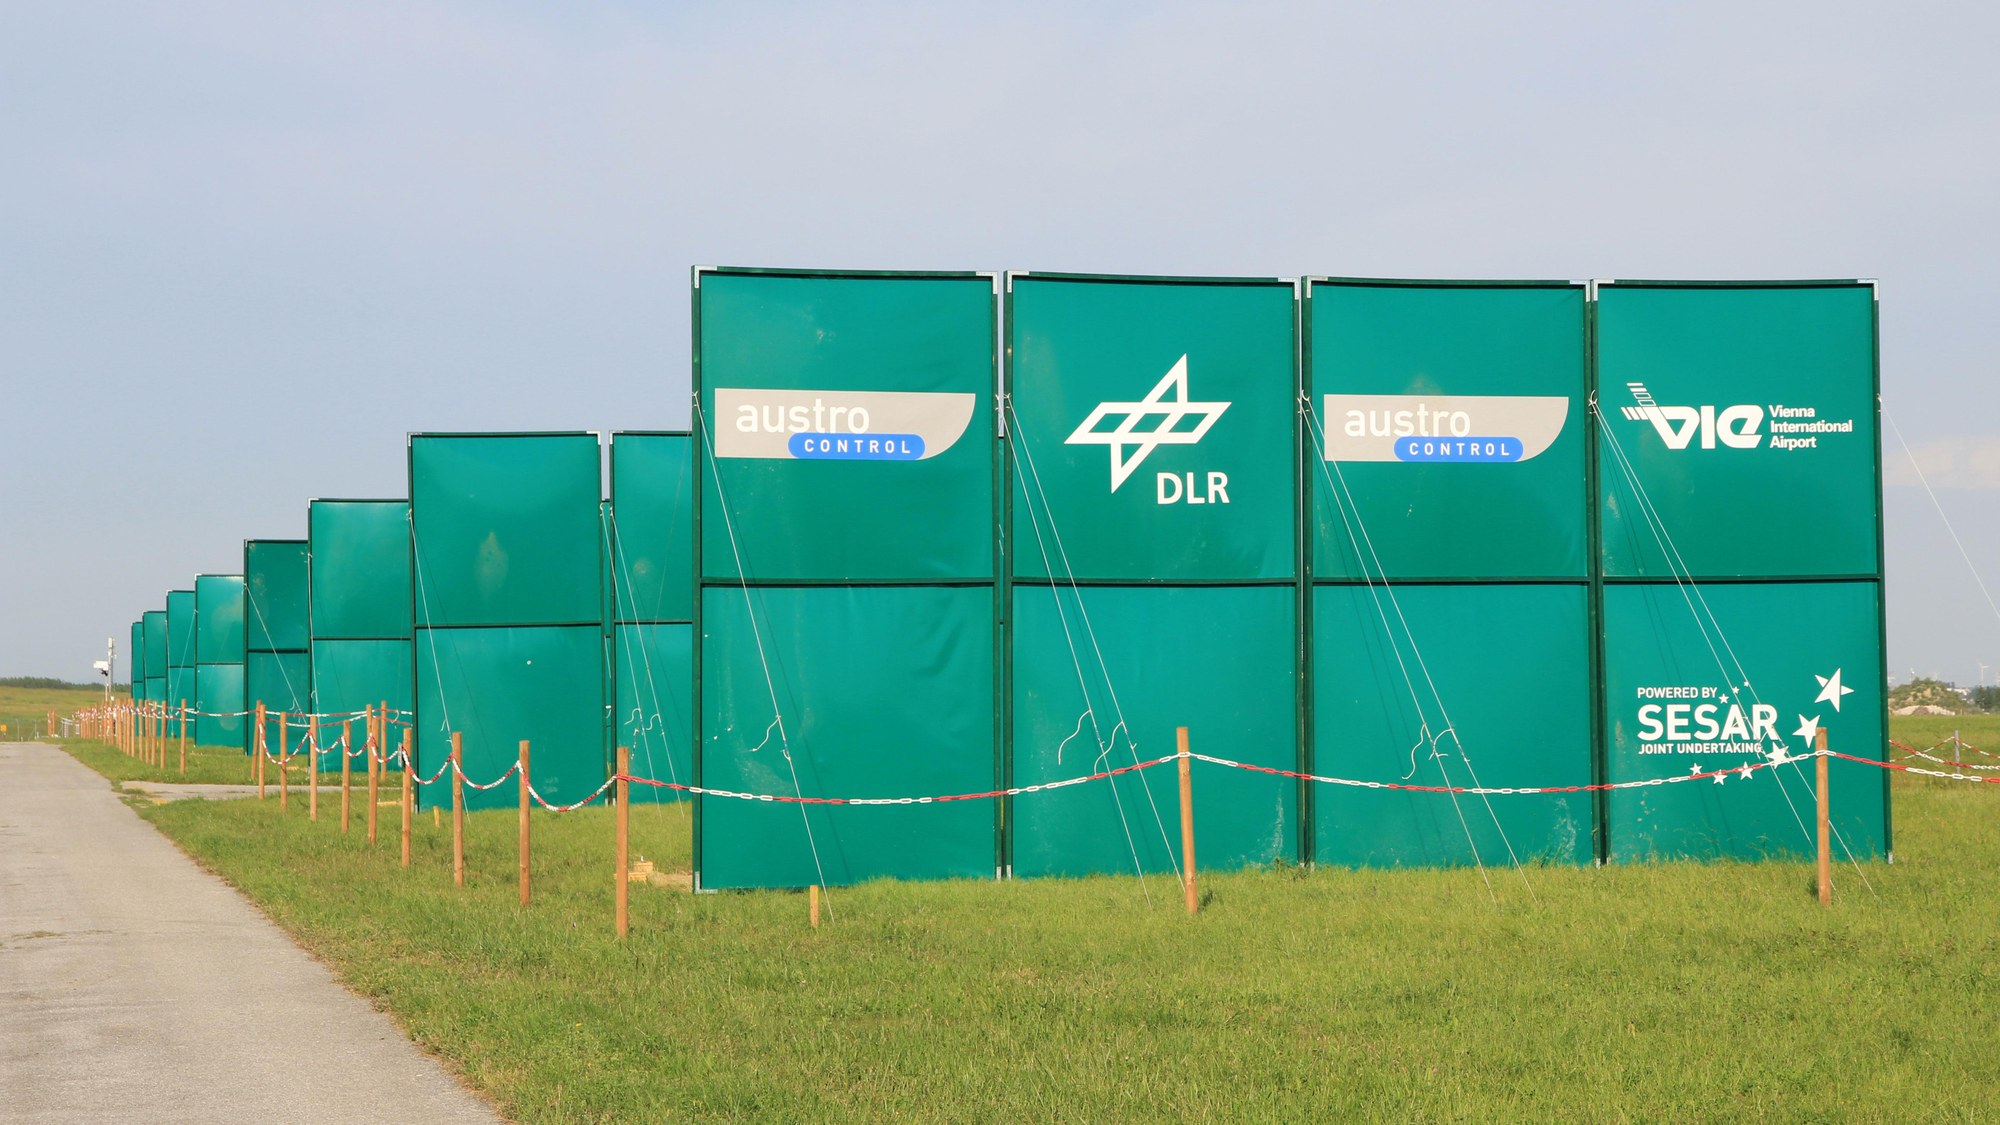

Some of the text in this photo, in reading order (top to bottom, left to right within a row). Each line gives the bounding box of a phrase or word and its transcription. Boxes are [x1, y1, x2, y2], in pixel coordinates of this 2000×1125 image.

[736, 398, 870, 434] austro
[1768, 404, 1815, 418] Vienna
[1344, 402, 1471, 438] austro
[1769, 419, 1853, 433] International
[804, 438, 911, 454] CONTROL
[1409, 442, 1510, 456] CONTROL
[1769, 434, 1817, 451] Airport
[1156, 471, 1230, 505] DLR
[1637, 687, 1718, 699] POWERED BY
[1637, 703, 1781, 741] SESAR
[1638, 742, 1763, 755] JOINT UNDERTAKING
